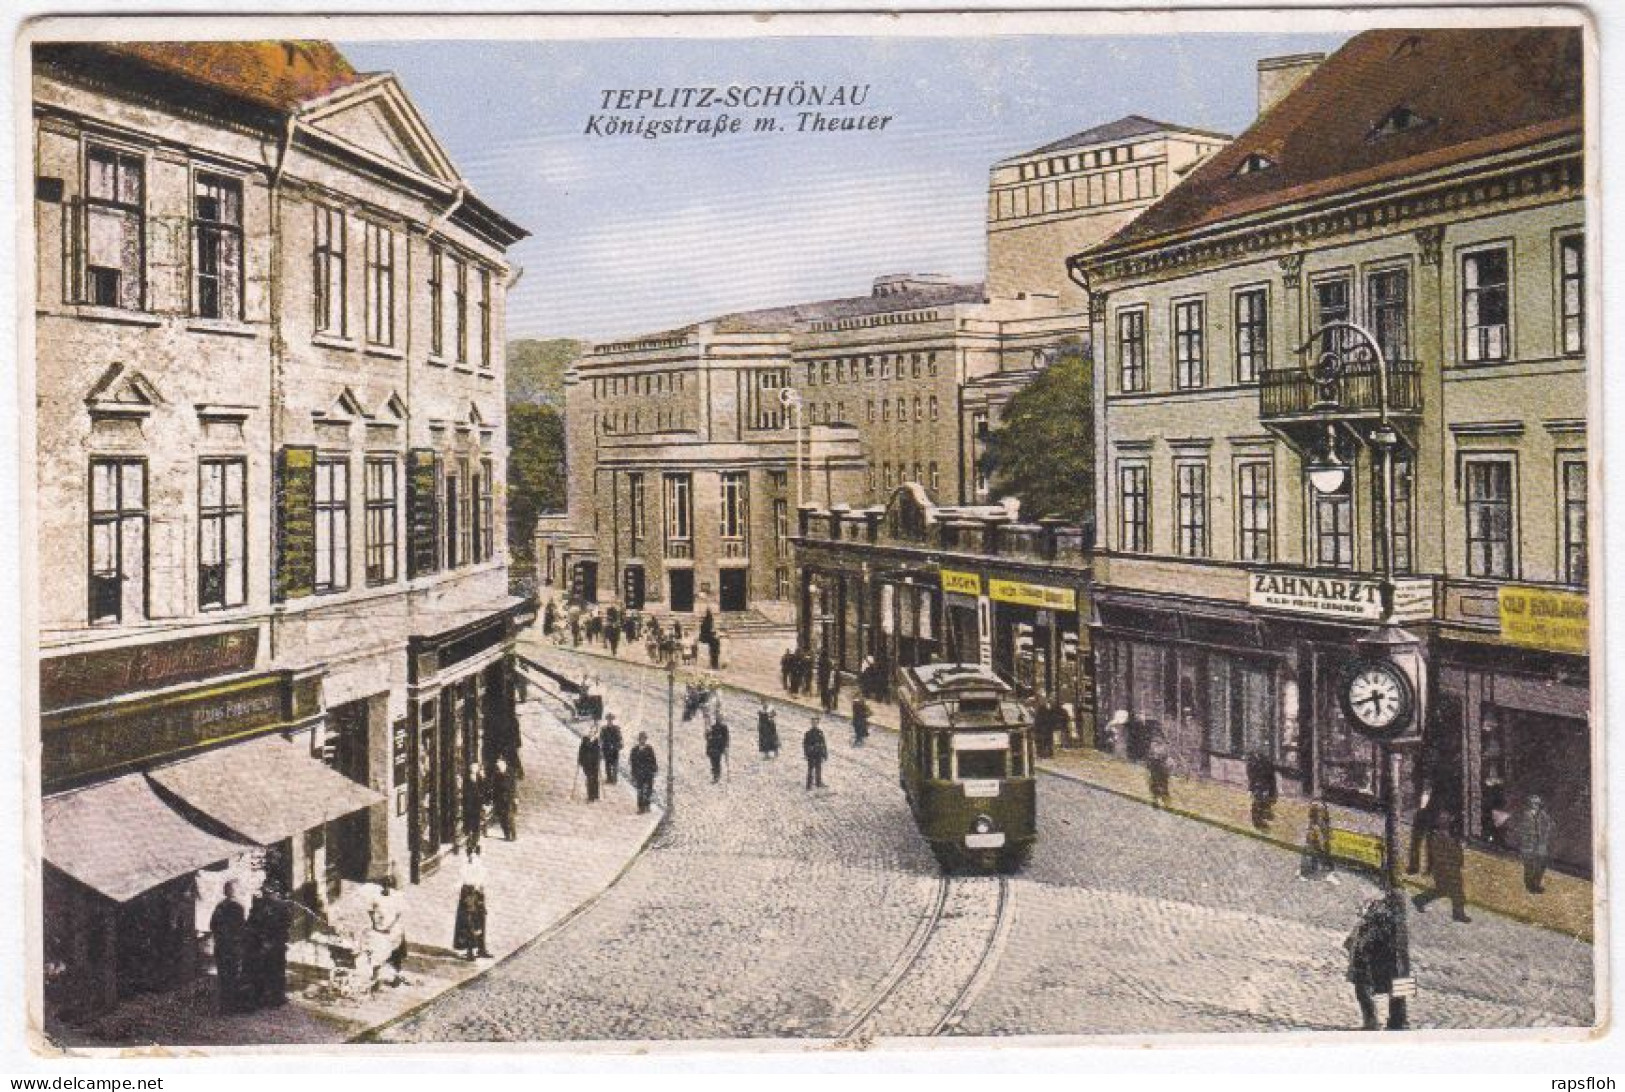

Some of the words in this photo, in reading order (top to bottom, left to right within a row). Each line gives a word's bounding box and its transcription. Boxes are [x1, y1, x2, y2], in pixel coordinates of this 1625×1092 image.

[600, 81, 871, 109] TEPLITZ-SCHÖNAU
[584, 113, 742, 139] Königstraße
[754, 116, 785, 132] m.
[1254, 574, 1380, 604] ZAHNARZT
